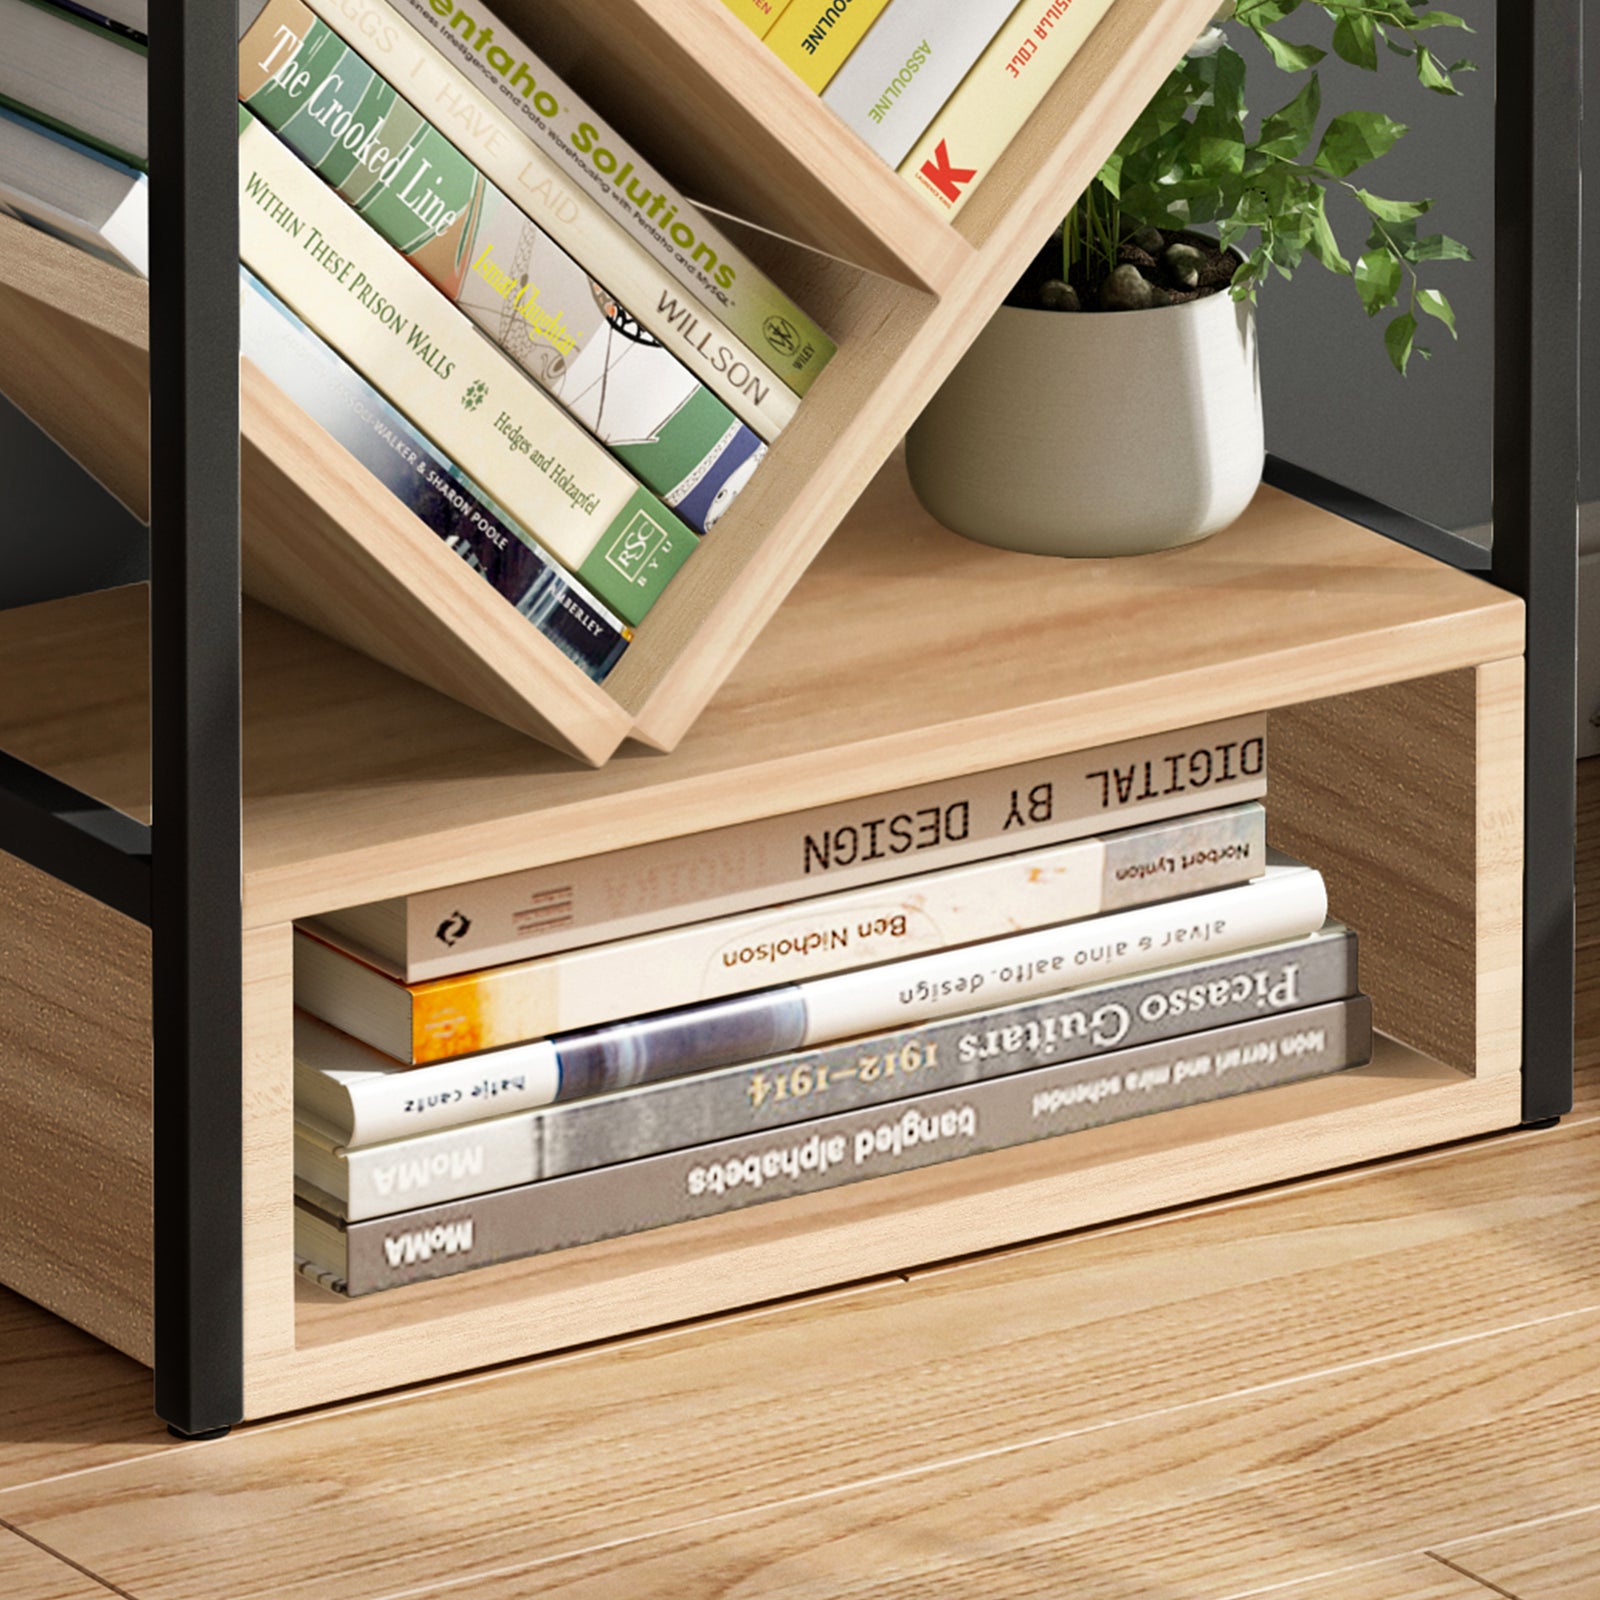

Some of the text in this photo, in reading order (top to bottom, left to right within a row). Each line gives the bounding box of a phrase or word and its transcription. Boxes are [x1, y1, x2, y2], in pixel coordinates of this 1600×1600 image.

[801, 0, 851, 55] OULINE
[1004, 0, 1072, 79] SILLA COLE
[868, 39, 932, 124] ASSOULINE
[257, 25, 457, 237] The Crooked Line
[329, 0, 580, 226] GGS I HAVE LAID
[440, 25, 498, 84] Intelligence
[499, 84, 521, 106] and
[521, 103, 546, 130] Data
[548, 126, 610, 194] Warehousing
[611, 190, 632, 213] with
[633, 211, 674, 254] Pentaho
[674, 252, 696, 275] and
[920, 137, 978, 203] K
[571, 122, 736, 289] Solutions
[244, 171, 456, 380] WITHIN THESE PRISON WALLS
[472, 243, 583, 356] Ismat Chughtai
[656, 289, 770, 406] WILLSON
[792, 342, 815, 370] WILEY
[493, 411, 601, 516] Hedges and Holzapfel
[416, 461, 427, 474] &
[426, 470, 473, 516] SHARON
[470, 511, 508, 550] POOLE
[617, 521, 656, 568] RSC
[549, 582, 604, 637] AMBERLEY
[1085, 736, 1264, 808] DIGITAL
[1003, 782, 1053, 831] BY
[804, 800, 969, 874] DESIGN
[1115, 843, 1250, 881] Norbert Lynton
[722, 914, 908, 968] Ben Nicholson
[1074, 941, 1128, 964] aino
[1162, 920, 1226, 947] alvar
[899, 973, 985, 1004] design
[1139, 962, 1301, 1022] Picasso
[958, 1003, 1131, 1063] Guitars
[1215, 1041, 1278, 1076] ferrari
[404, 1076, 526, 1112] hatje cantz
[1032, 1075, 1123, 1117] schendel
[1125, 1064, 1173, 1092] mira
[1172, 1054, 1212, 1085] and
[372, 1145, 485, 1195] MoMA
[687, 1105, 977, 1195] tangled alphabets
[384, 1218, 474, 1268] MoMA
